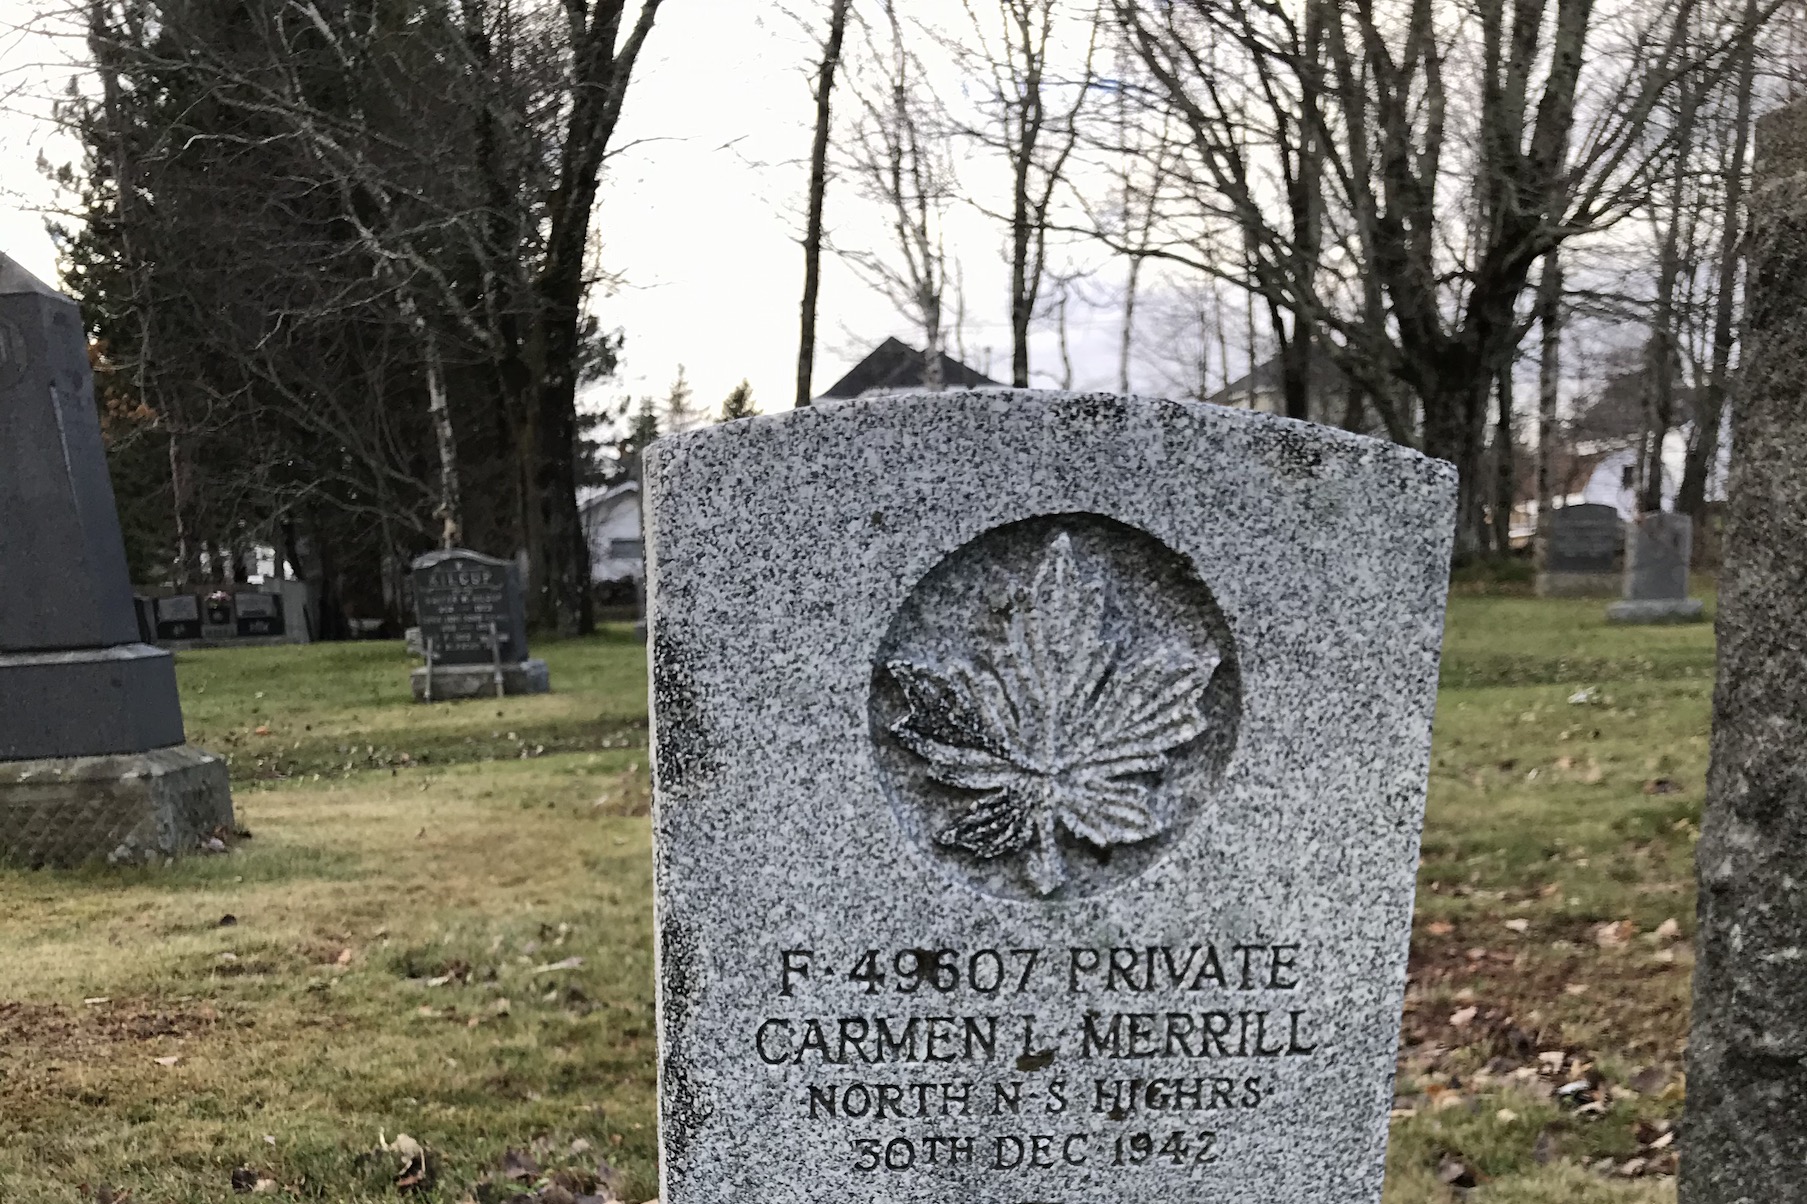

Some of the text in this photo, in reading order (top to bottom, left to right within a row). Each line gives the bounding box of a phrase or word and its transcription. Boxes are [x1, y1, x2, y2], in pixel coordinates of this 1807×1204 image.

[1067, 942, 1302, 993] PRIVATE
[754, 1014, 1000, 1066] CARMEN
[1081, 1009, 1318, 1060] MERRILL
[806, 1081, 974, 1120] NORTH
[850, 1129, 1218, 1173] 30TH DEC 1942
